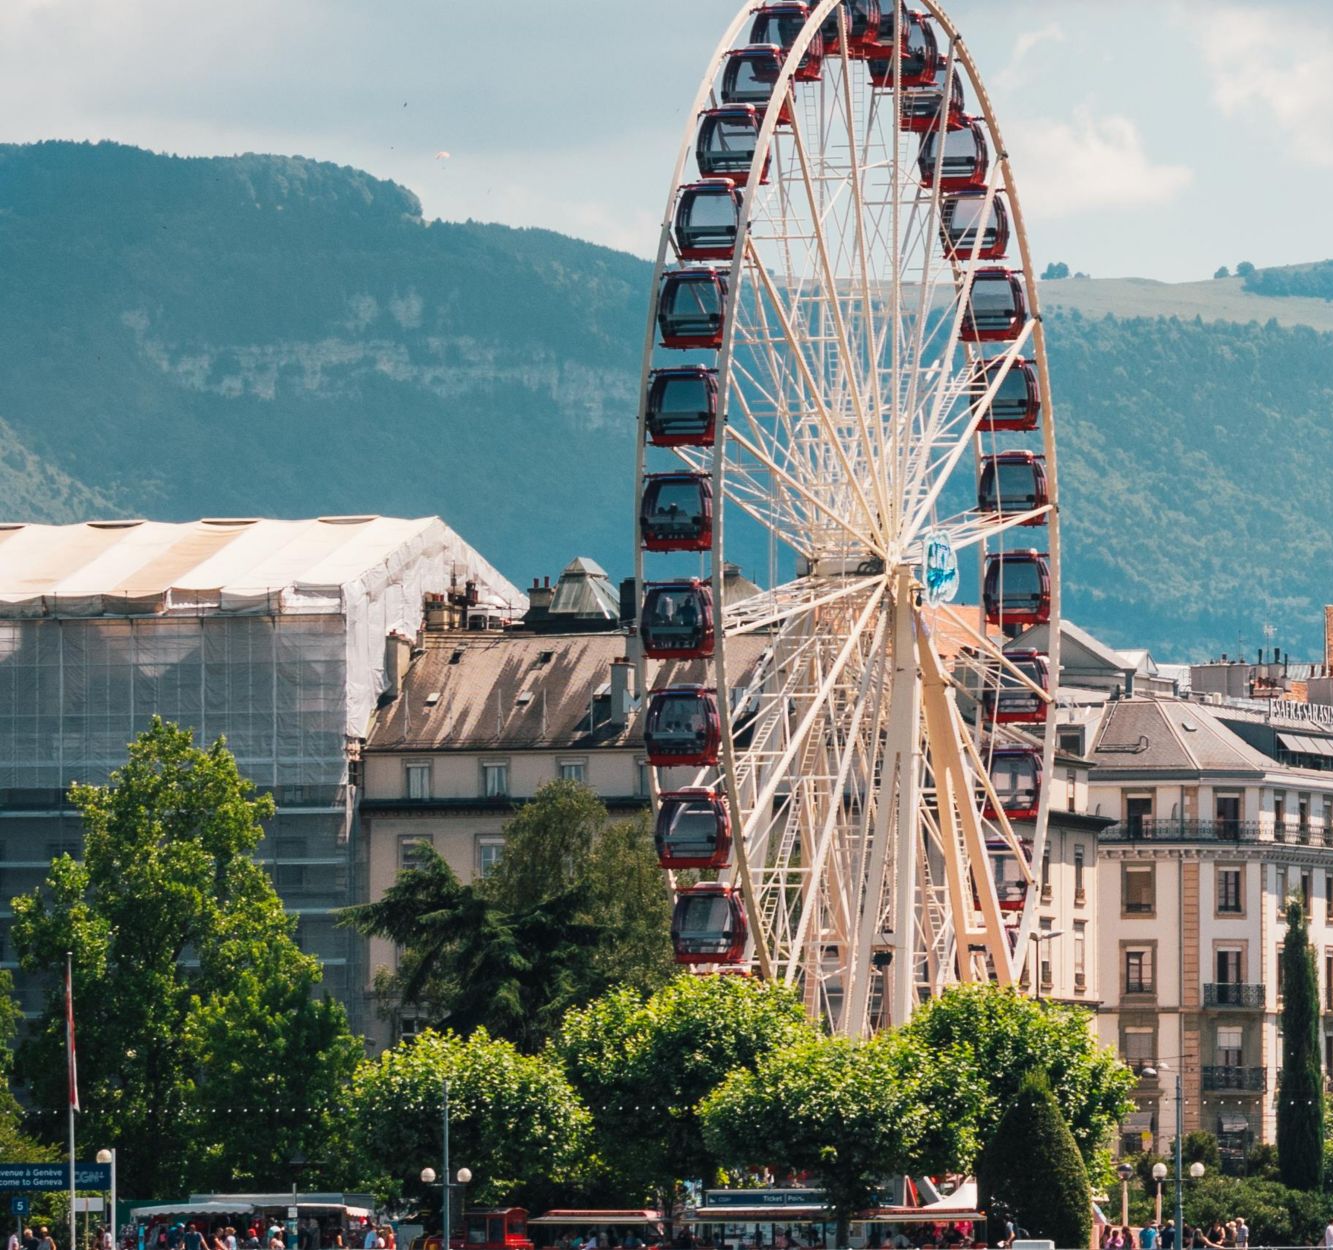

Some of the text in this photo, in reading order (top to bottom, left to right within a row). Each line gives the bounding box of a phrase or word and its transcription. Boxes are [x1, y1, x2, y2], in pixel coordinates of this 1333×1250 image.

[32, 1168, 63, 1177] Genève
[32, 1178, 63, 1186] Geneva
[17, 1201, 24, 1211] 5
